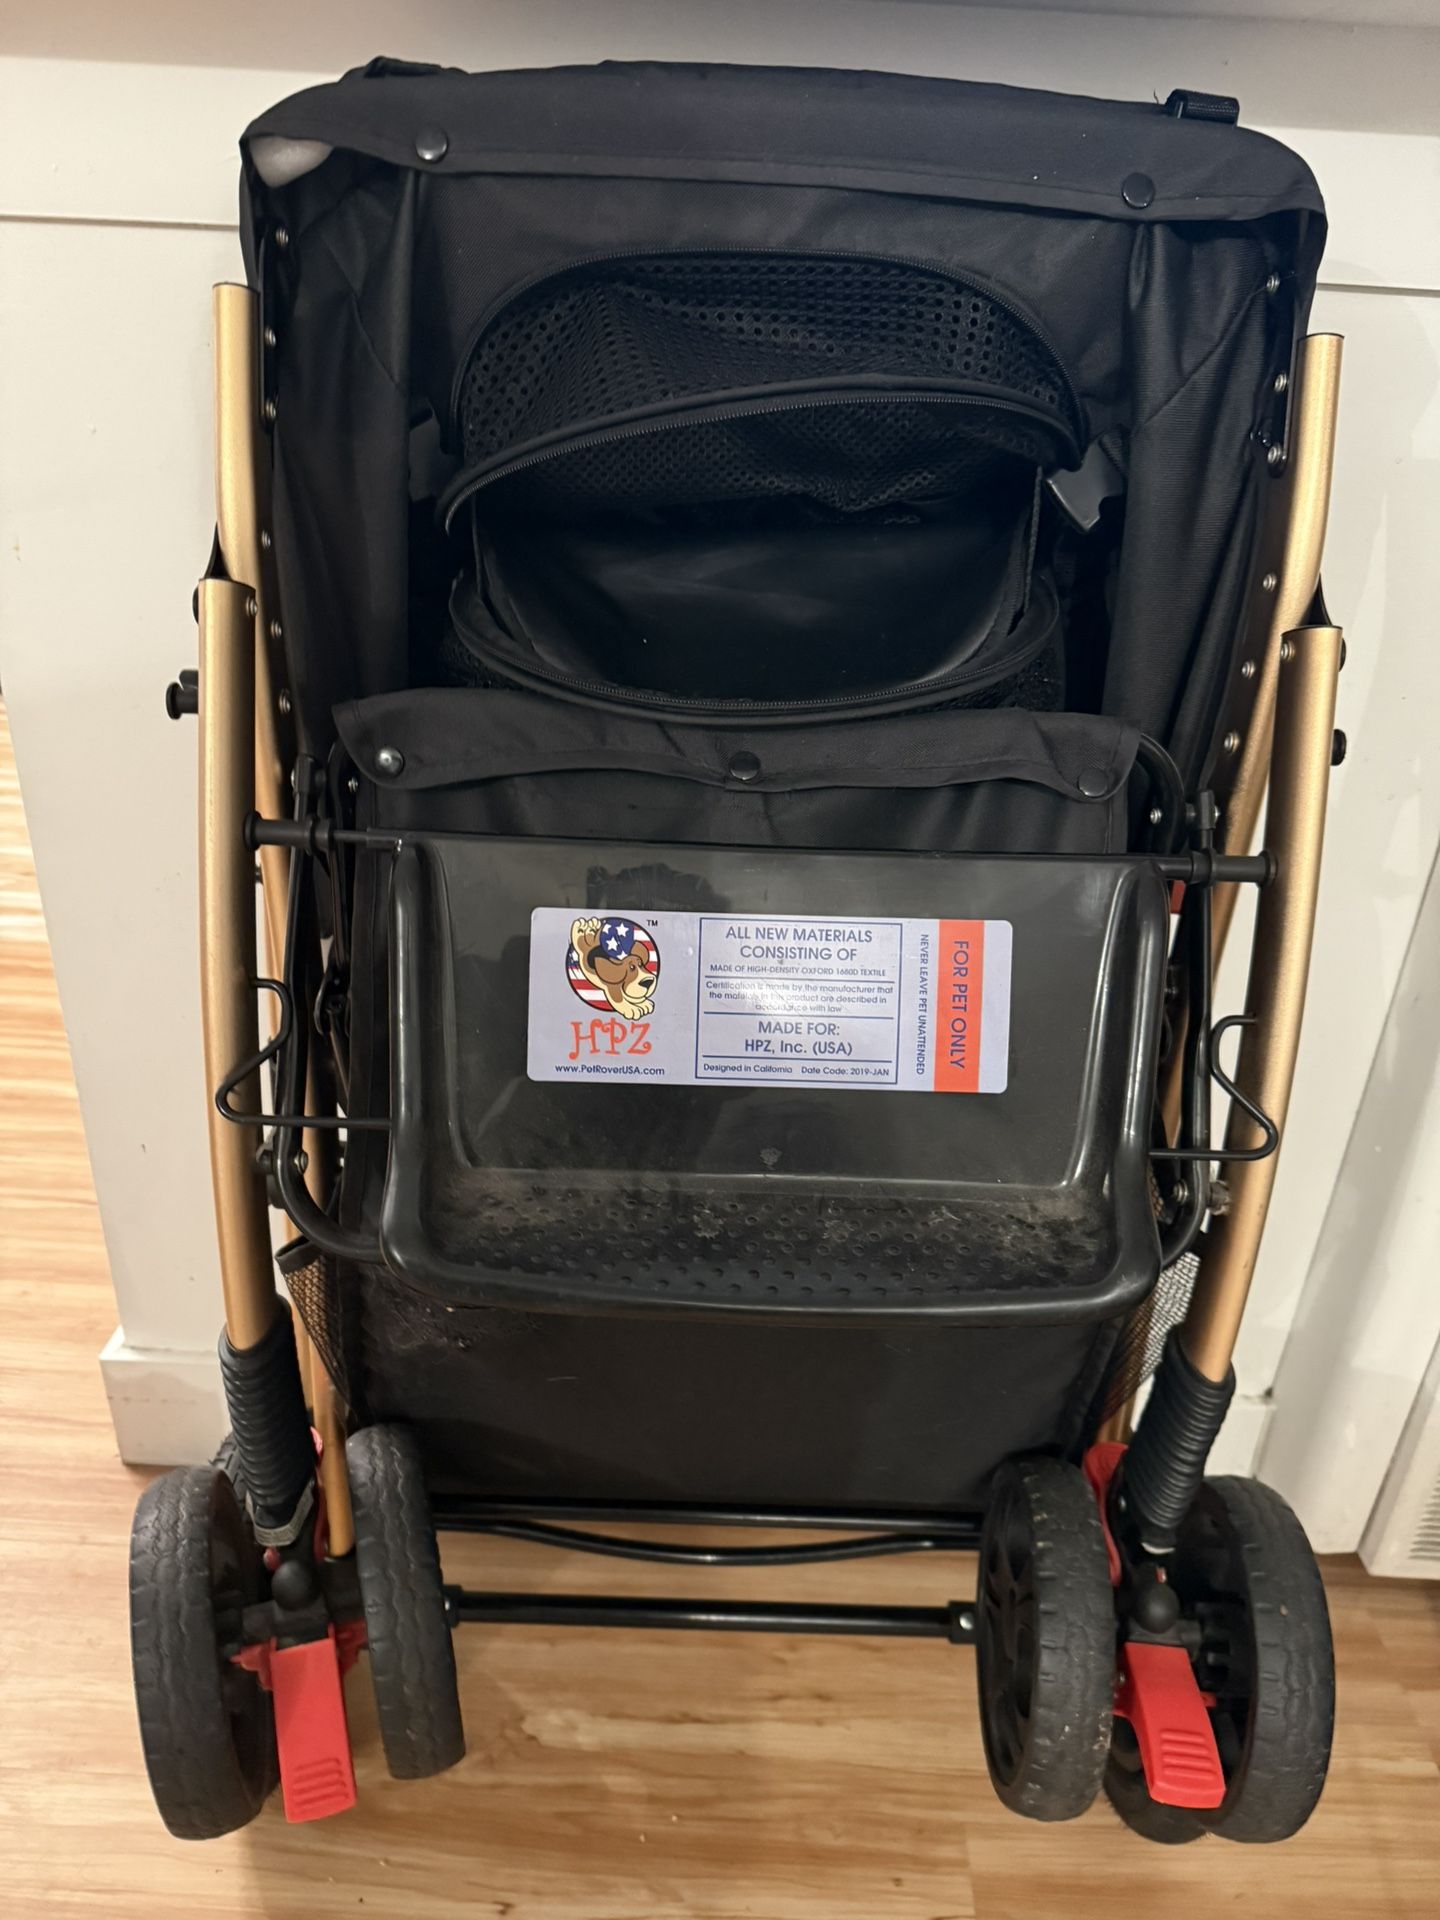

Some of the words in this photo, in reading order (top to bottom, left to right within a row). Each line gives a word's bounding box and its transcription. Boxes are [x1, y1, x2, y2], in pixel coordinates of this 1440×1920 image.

[726, 926, 751, 939] ALL
[755, 928, 788, 940] NEW
[793, 929, 872, 943] MATERIALS
[740, 945, 832, 960] CONSISTING
[837, 948, 857, 961] OF
[920, 934, 929, 964] NEVER
[953, 941, 969, 976] FOR
[710, 964, 732, 972] MADE
[735, 965, 745, 973] OF
[747, 966, 799, 974] HIGH-DENSITY
[802, 967, 833, 975] OXFORD
[860, 969, 886, 977] TEXTILE
[706, 981, 755, 990] Certification
[792, 983, 803, 993] by
[805, 983, 817, 992] the
[820, 984, 875, 994] manufacturer
[877, 985, 893, 994] that
[919, 967, 928, 995] LEAVE
[709, 991, 722, 999] the
[787, 993, 818, 1004] product
[836, 994, 877, 1004] described
[880, 995, 886, 1004] in
[919, 997, 927, 1012] PET
[952, 984, 968, 1012] PET
[810, 1004, 826, 1012] with
[828, 1004, 842, 1013] law
[759, 1021, 802, 1034] MADE
[807, 1023, 840, 1036] FOR:
[569, 1017, 652, 1060] HPZ
[917, 1015, 927, 1075] UNATTENDED
[950, 1018, 967, 1069] ONLY
[745, 1039, 775, 1054] HPZ,
[780, 1040, 807, 1054] Inc.
[813, 1041, 852, 1056] (USA)
[555, 1064, 665, 1075] www.PetRoverUSA.com
[704, 1064, 742, 1074] Designed
[744, 1064, 751, 1072] in
[753, 1064, 792, 1073] California
[802, 1066, 820, 1074] Date
[823, 1067, 848, 1075] Code:
[850, 1068, 889, 1076] 2019-JAN
